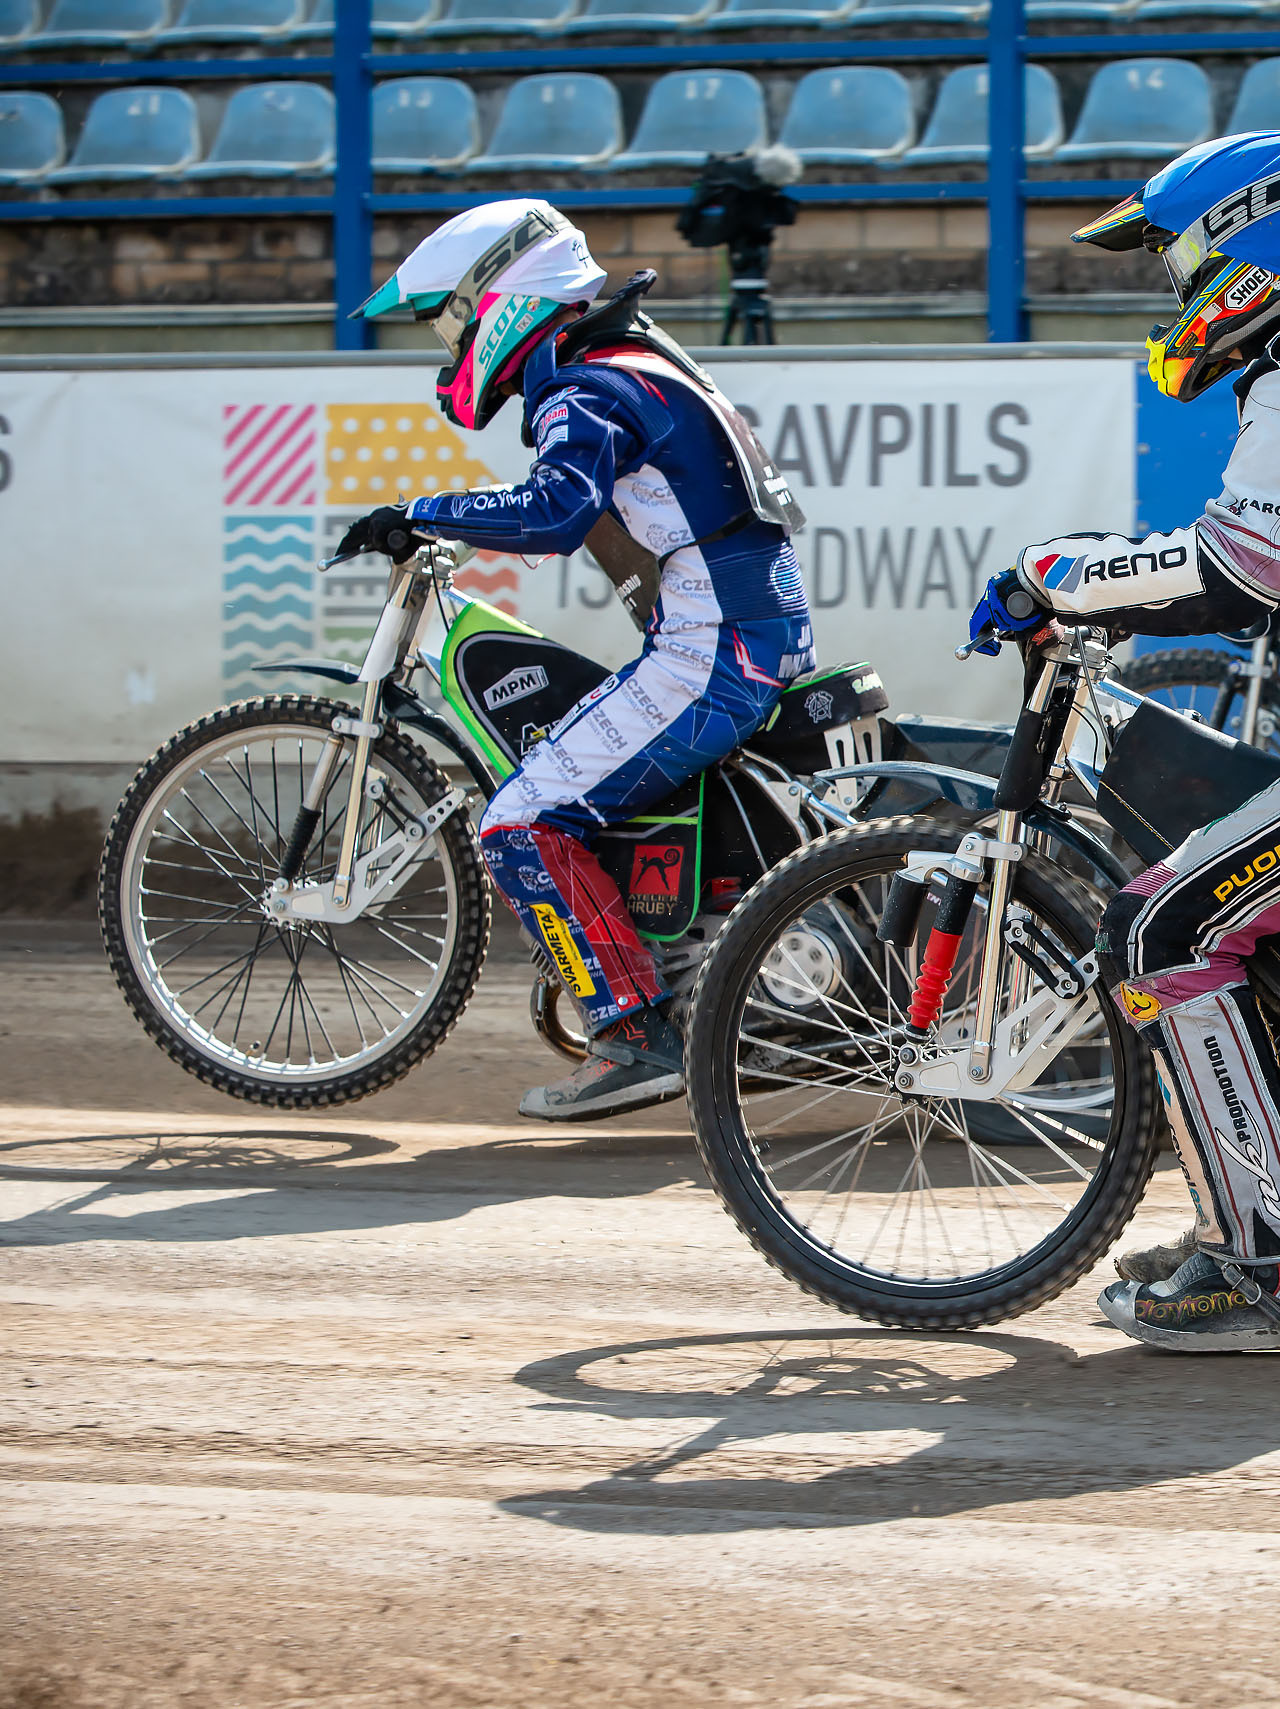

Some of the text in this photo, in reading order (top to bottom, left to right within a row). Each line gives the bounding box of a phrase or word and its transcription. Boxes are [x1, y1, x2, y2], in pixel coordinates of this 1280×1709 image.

[1230, 267, 1269, 306] SHOEI
[478, 295, 527, 369] SCOT
[742, 403, 1032, 488] AVPILS
[797, 526, 994, 610] DWAY
[1084, 545, 1188, 584] RENO
[681, 578, 713, 592] CZE
[667, 641, 714, 667] CZEC
[491, 673, 537, 702] MPM
[626, 676, 669, 727] CZECH
[592, 704, 628, 750] ZECH
[550, 740, 584, 779] ZECH
[627, 901, 676, 915] HRUBY
[1203, 1035, 1252, 1143] PROMOTION
